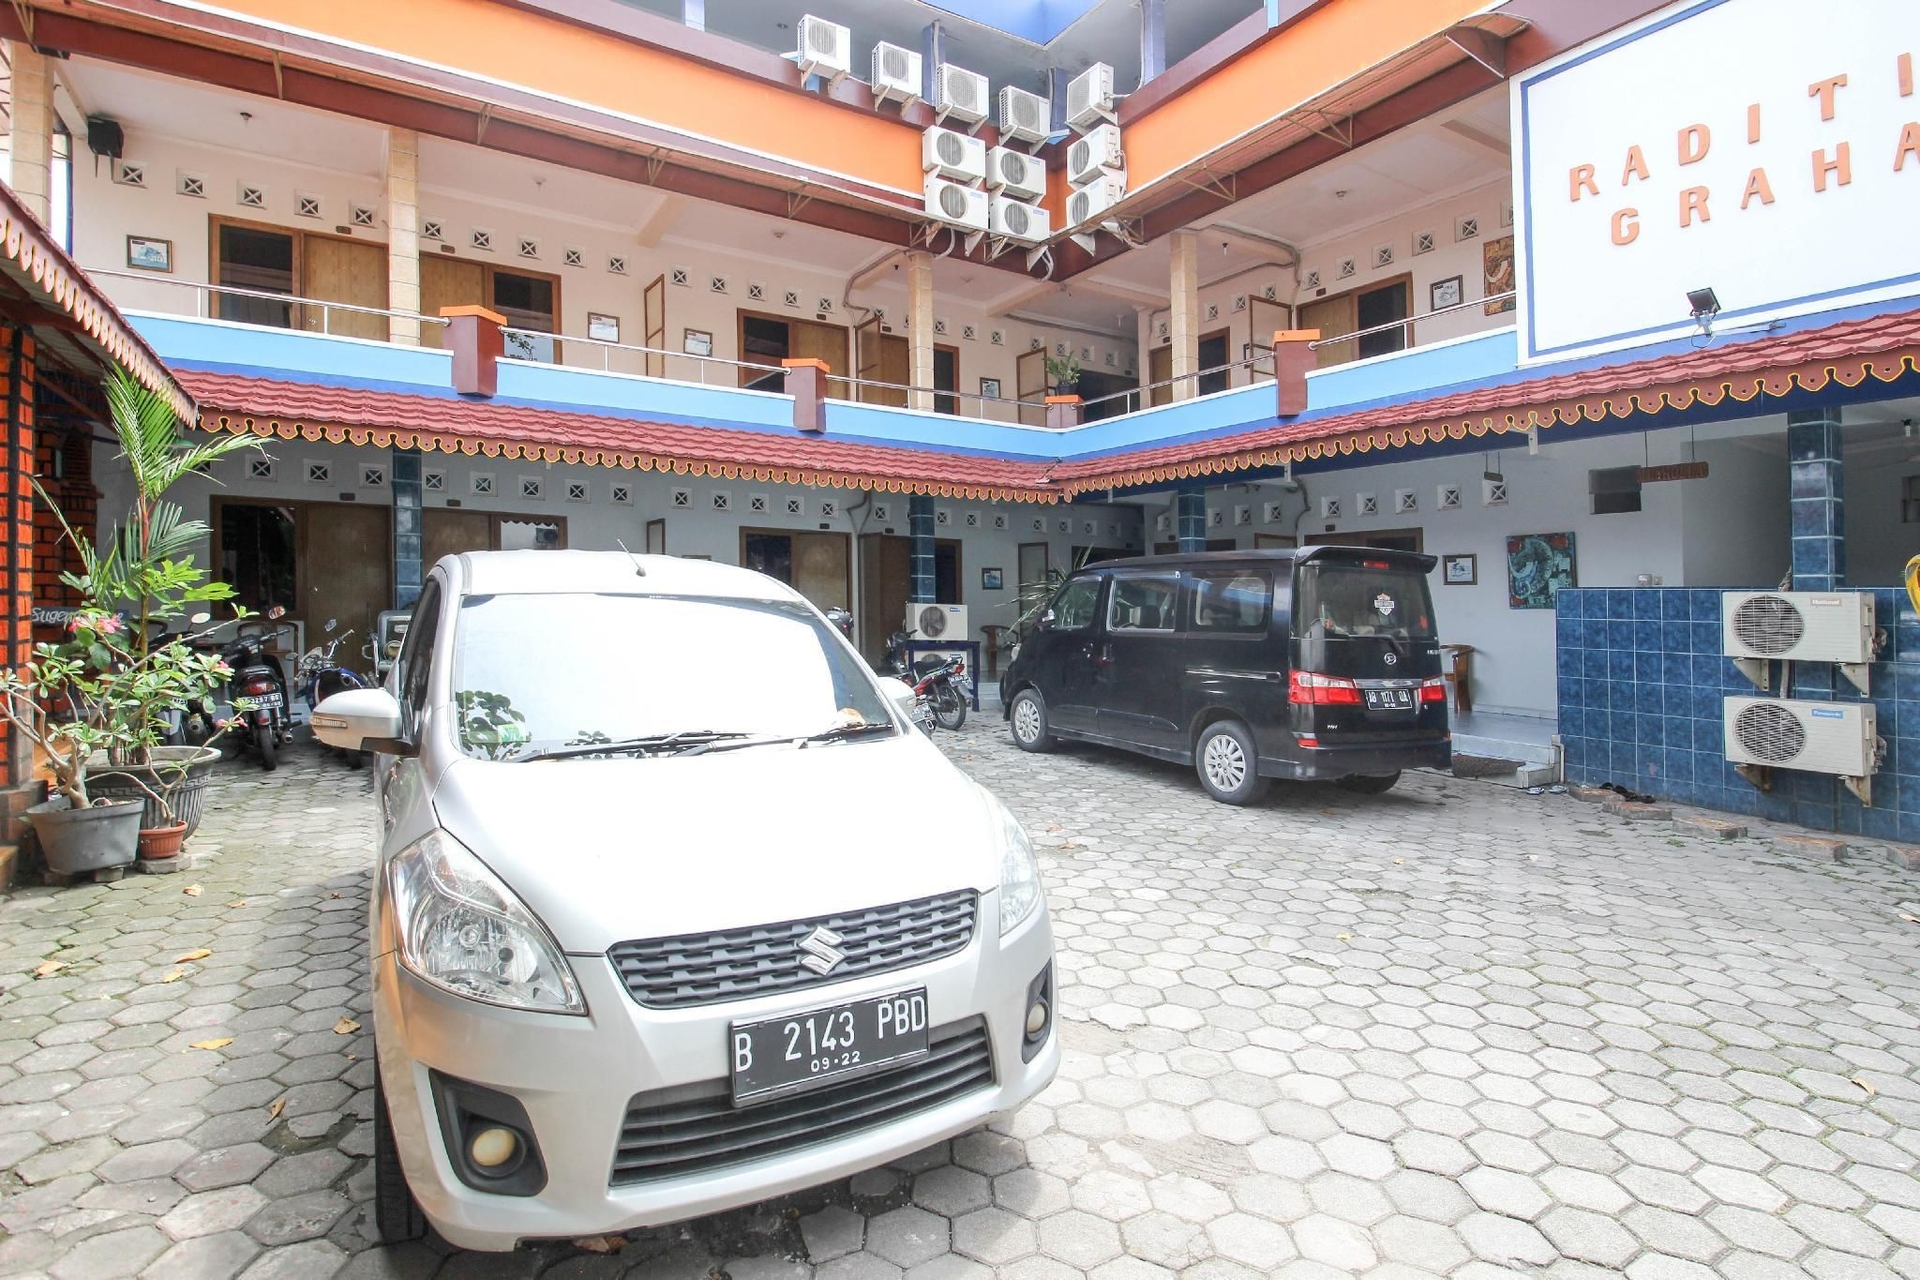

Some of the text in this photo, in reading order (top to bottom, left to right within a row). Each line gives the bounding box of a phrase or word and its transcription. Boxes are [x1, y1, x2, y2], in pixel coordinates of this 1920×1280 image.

[1611, 121, 1920, 245] GRAHA
[734, 995, 927, 1073] B 2143 PBD
